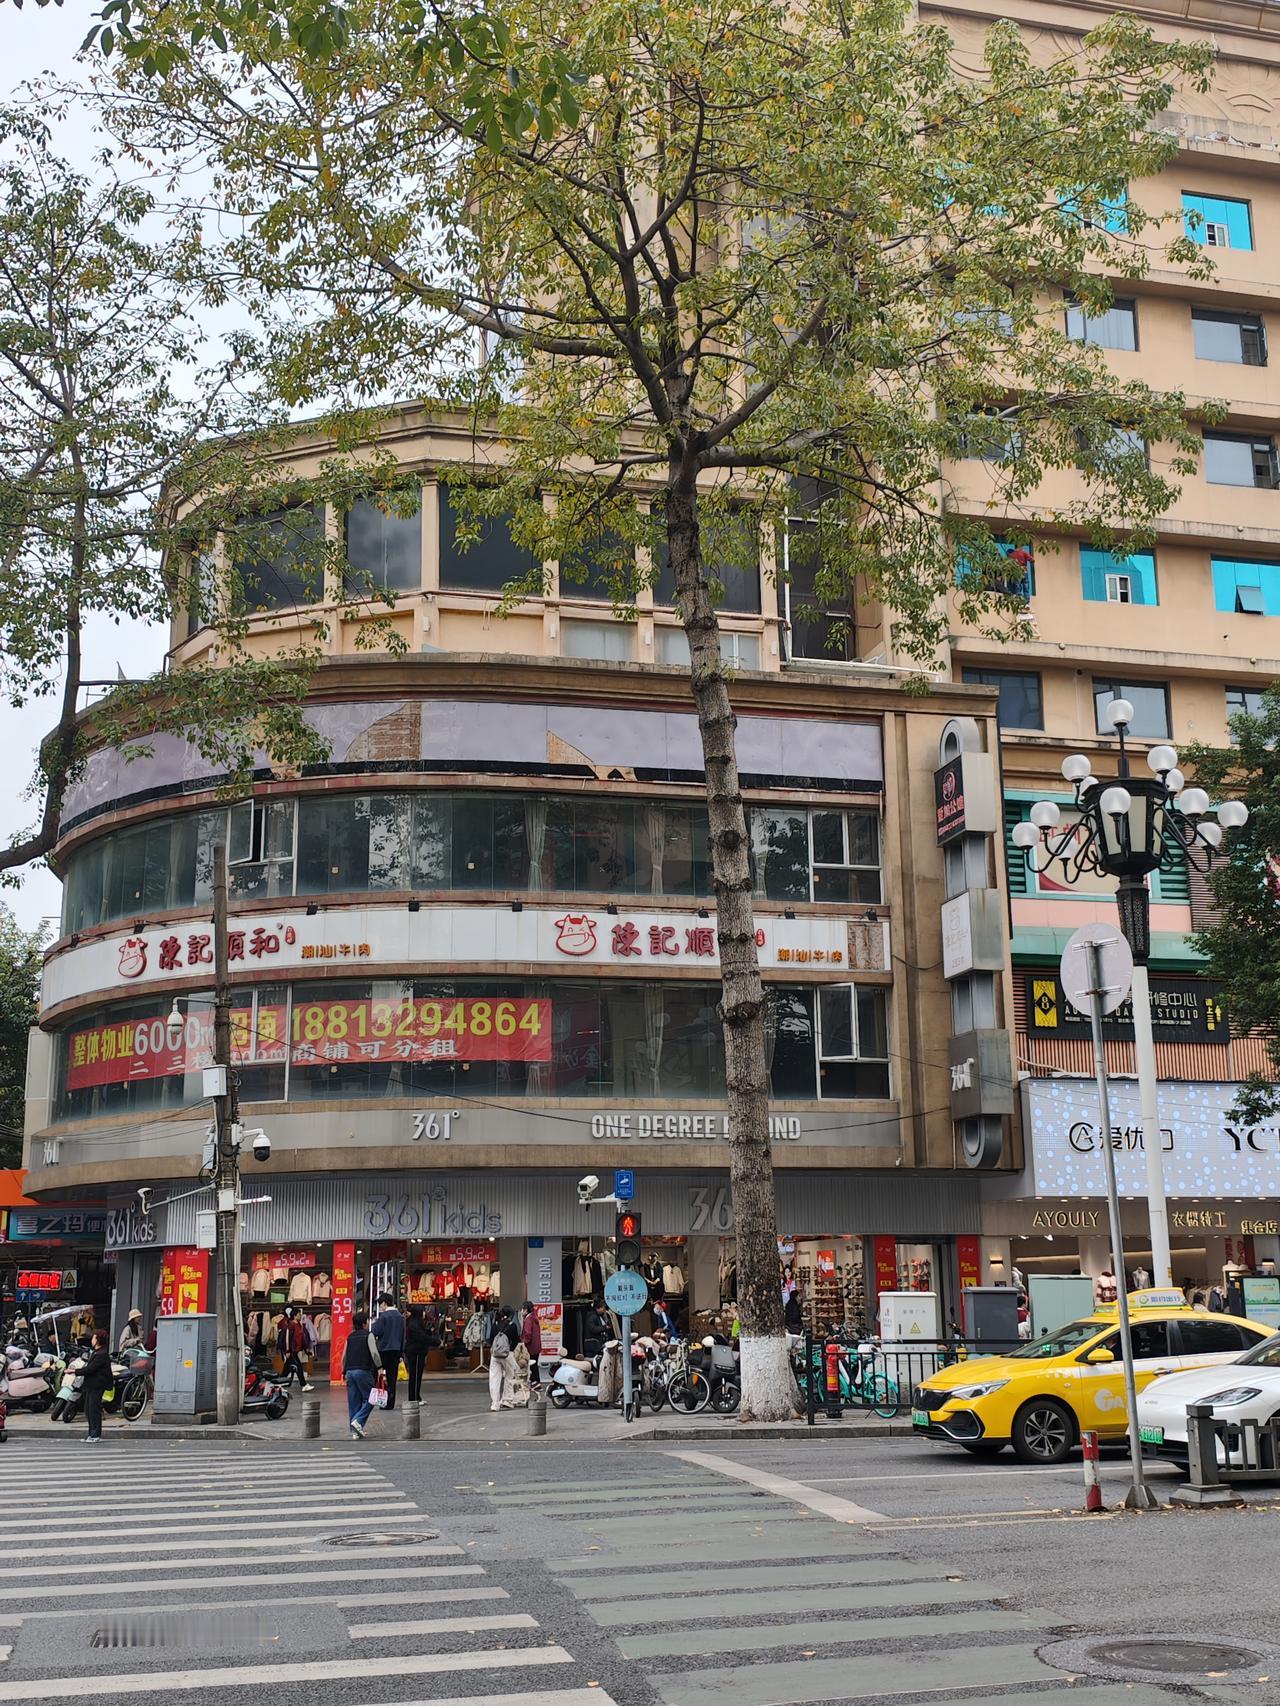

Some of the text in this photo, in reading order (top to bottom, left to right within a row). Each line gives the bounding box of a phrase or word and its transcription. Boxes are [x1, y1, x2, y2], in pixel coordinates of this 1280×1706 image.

[611, 922, 715, 957] 陳記順
[292, 1001, 542, 1040] 18813294864
[1157, 1008, 1198, 1019] STUDIO
[591, 1114, 631, 1138] ONE
[638, 1114, 716, 1139] DEGREE
[441, 1204, 502, 1234] kids
[688, 1187, 734, 1231] 36
[1033, 1211, 1099, 1228] AYOULY
[132, 1214, 154, 1242] kids
[539, 1257, 552, 1278] ONE
[539, 1281, 552, 1303] DEG
